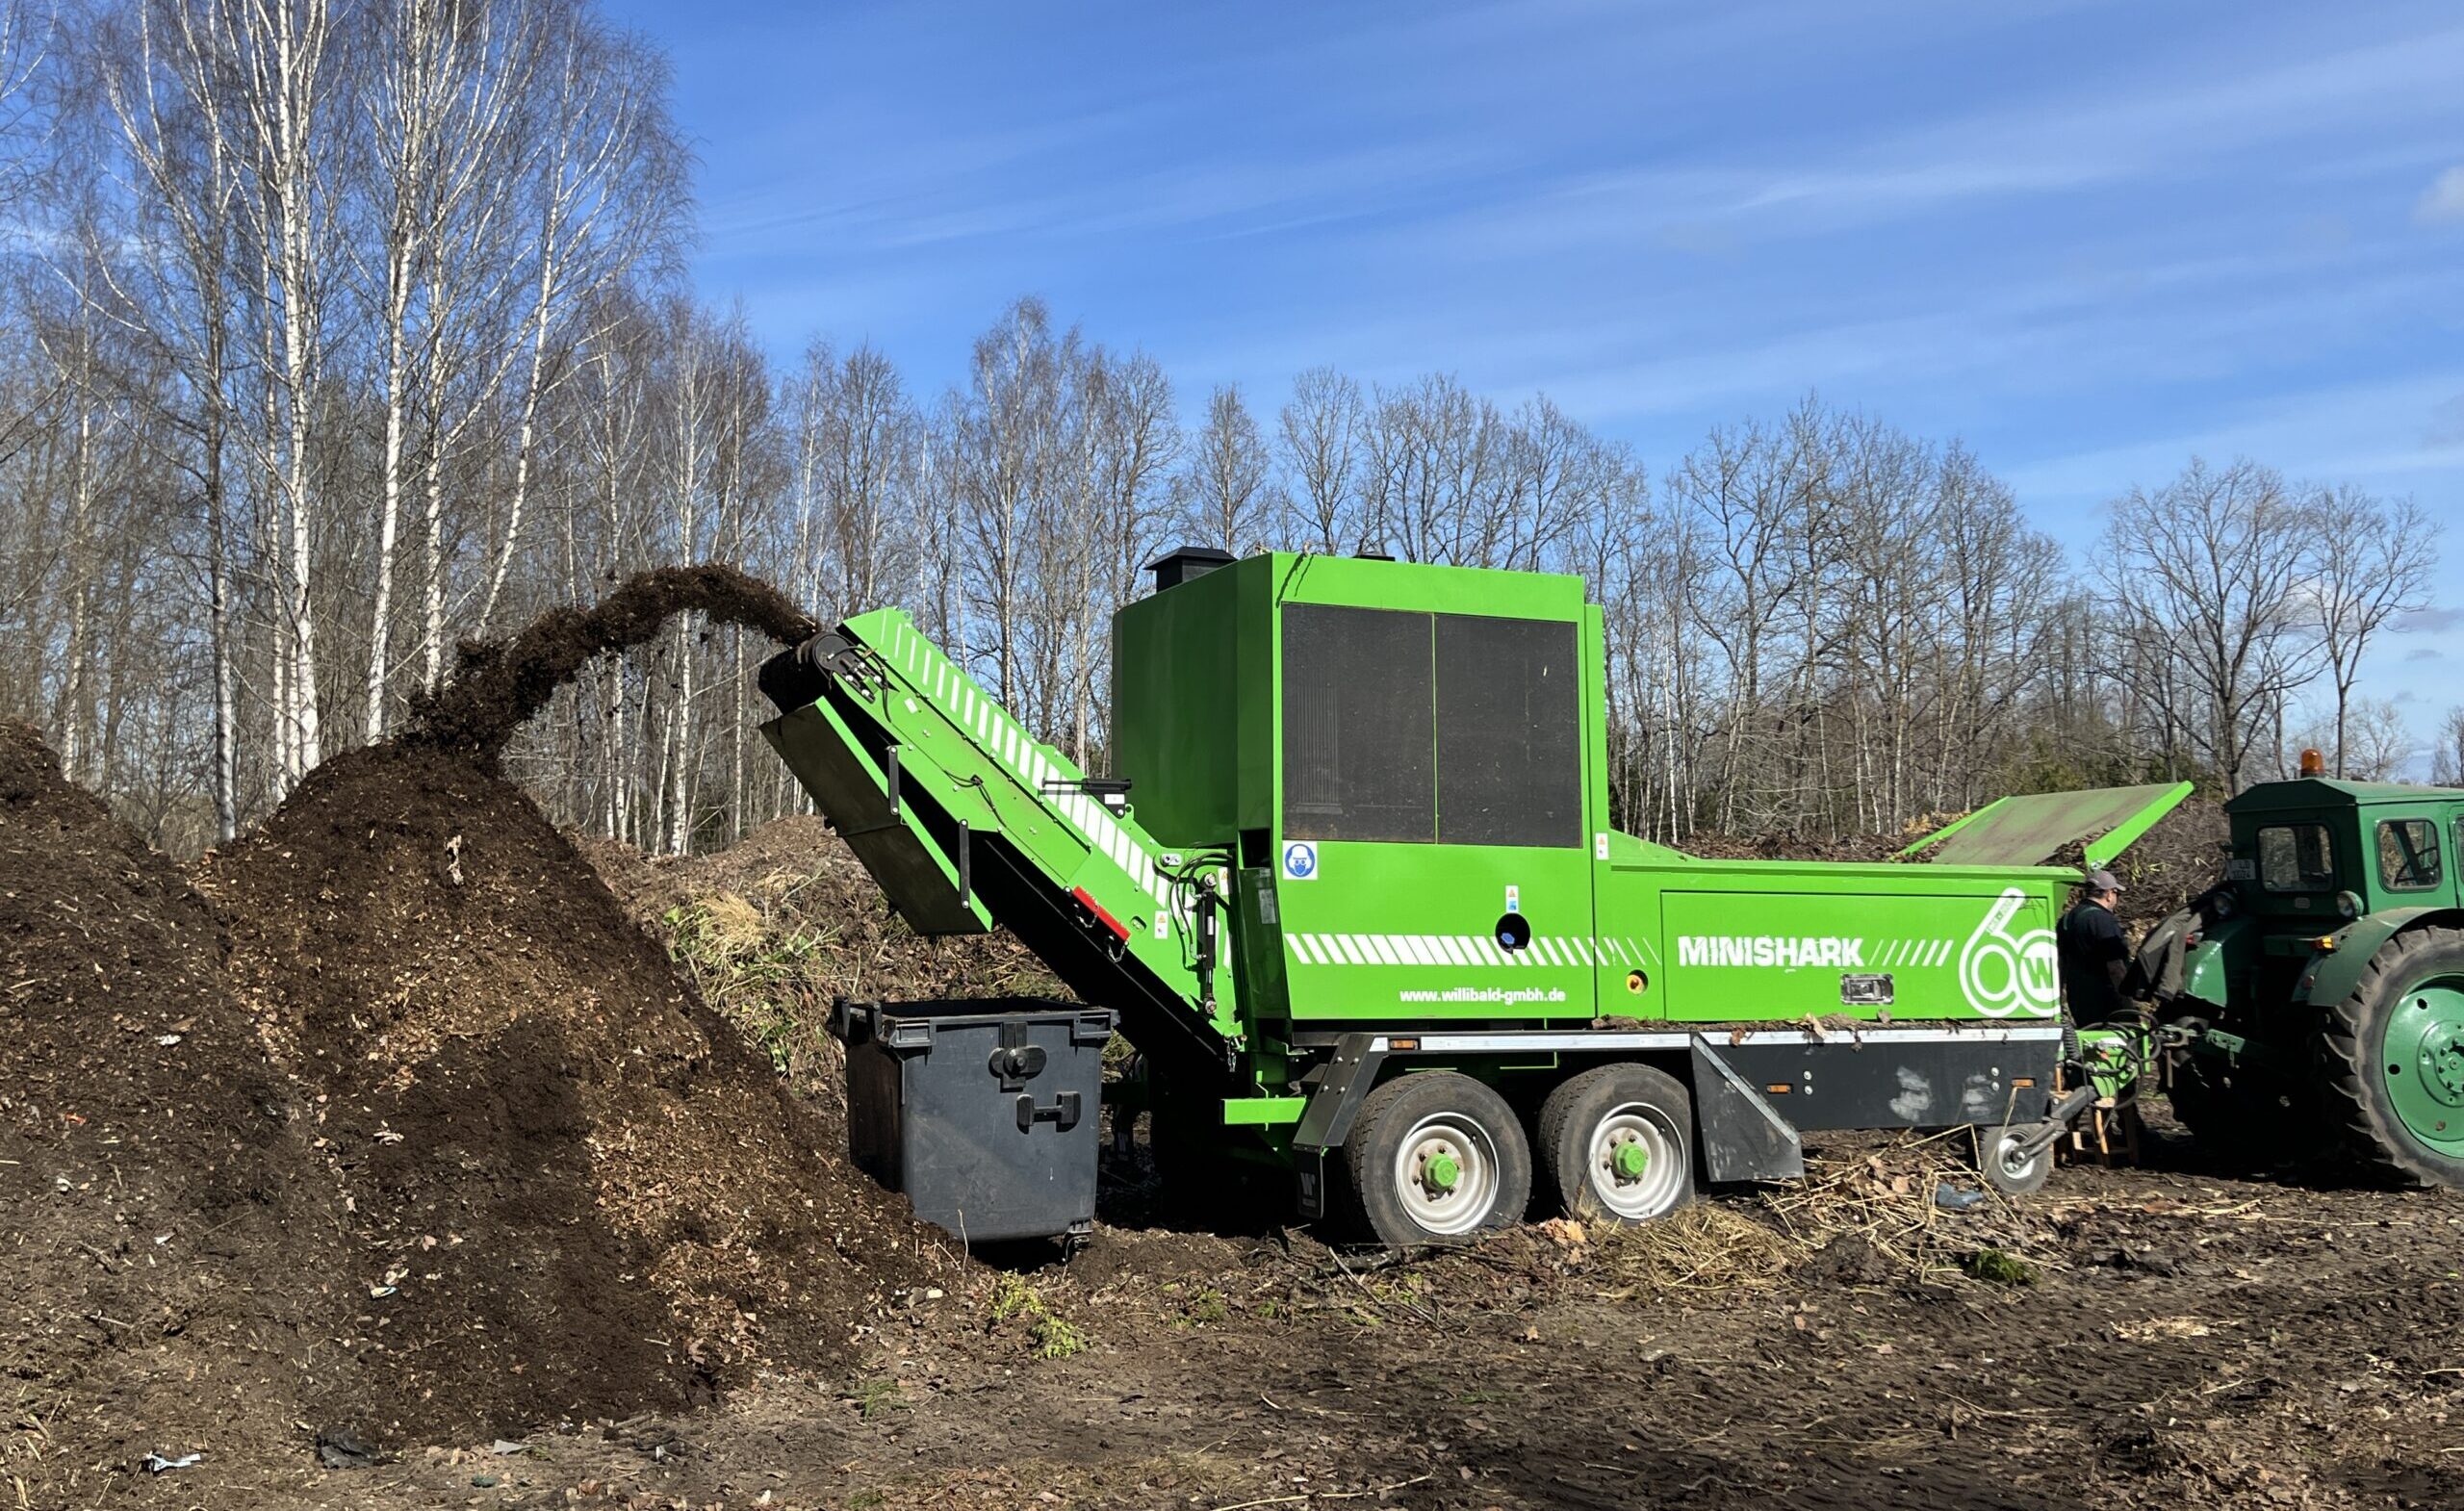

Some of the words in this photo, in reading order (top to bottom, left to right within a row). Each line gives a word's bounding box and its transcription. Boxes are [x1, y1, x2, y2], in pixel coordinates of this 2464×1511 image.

[1678, 935, 1864, 967] MINISHARK
[2022, 957, 2052, 989] W
[1399, 987, 1566, 1005] www.willibald-gmbh.de
